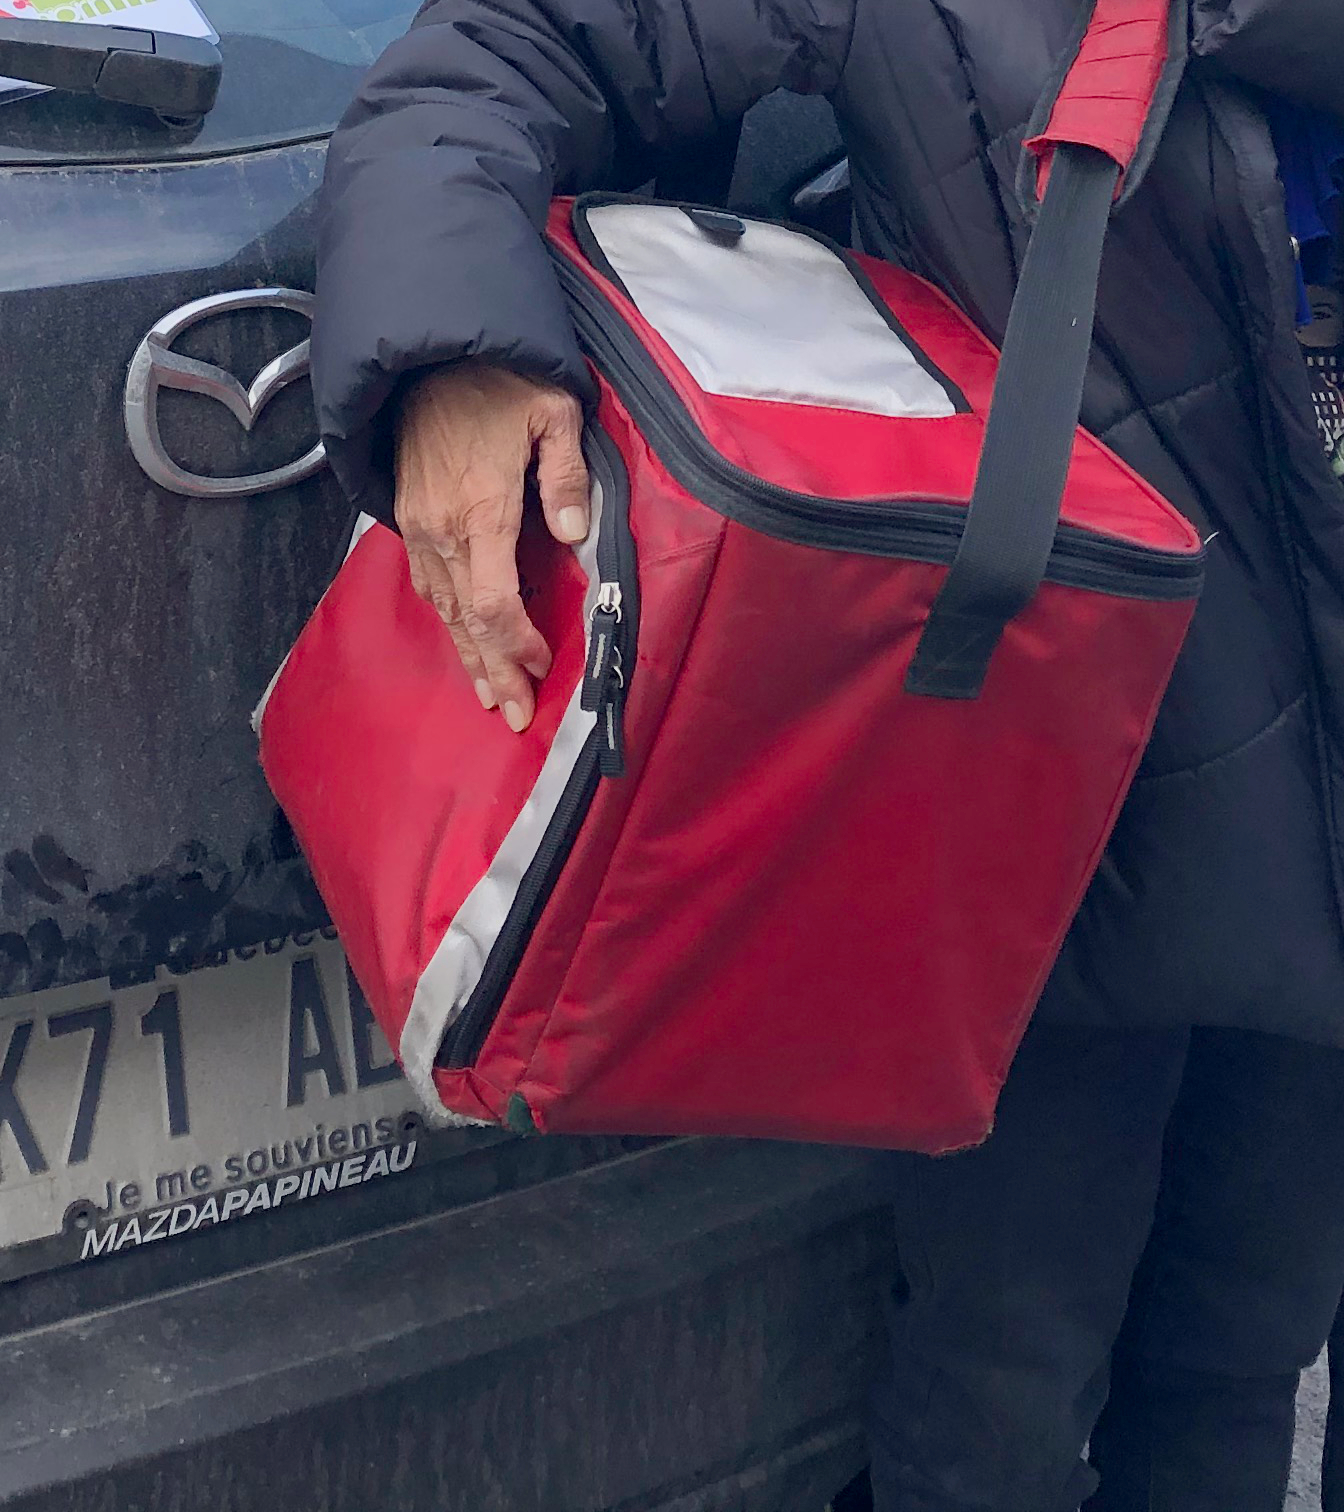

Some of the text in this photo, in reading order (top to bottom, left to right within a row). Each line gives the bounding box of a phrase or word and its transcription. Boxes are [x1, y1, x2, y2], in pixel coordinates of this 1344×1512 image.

[81, 1140, 418, 1260] MAZDAPAPINEAU
[101, 1114, 392, 1214] Je me souviens
